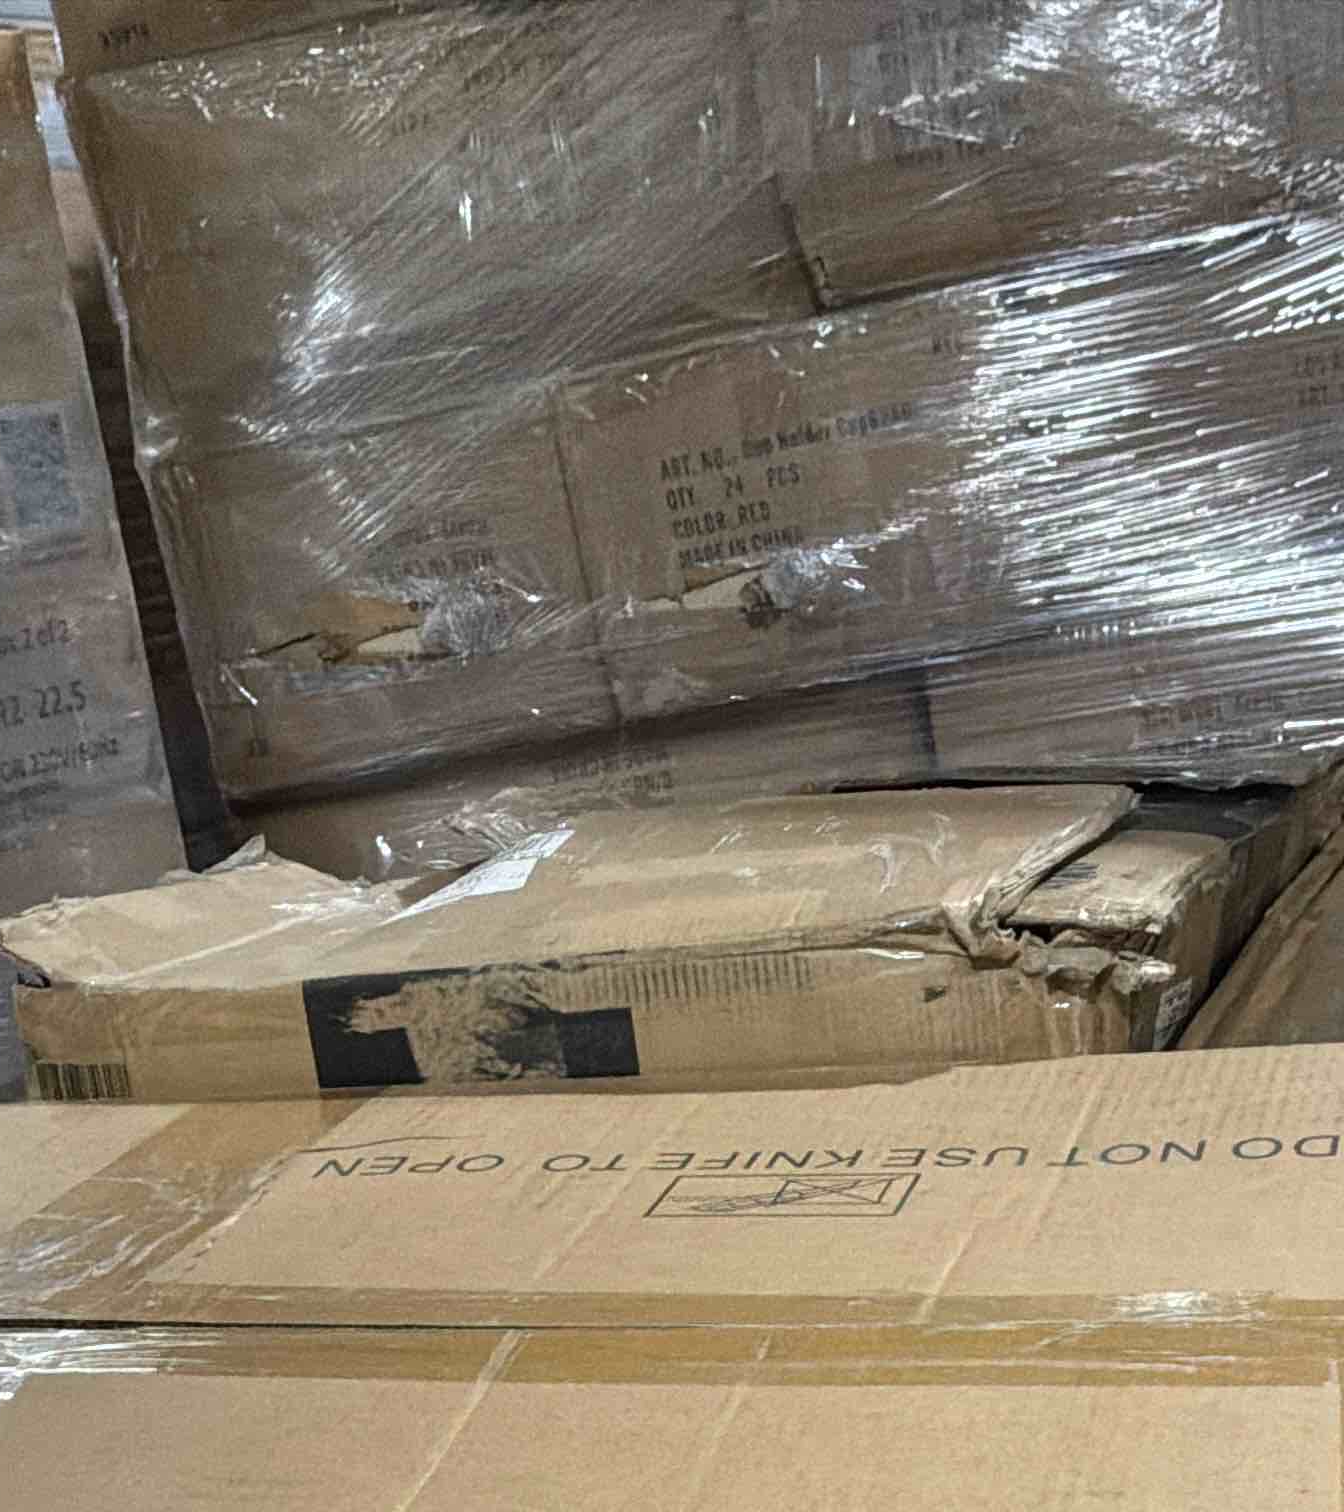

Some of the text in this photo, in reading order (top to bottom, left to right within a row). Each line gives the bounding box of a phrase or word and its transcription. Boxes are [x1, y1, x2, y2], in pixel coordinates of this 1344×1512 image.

[313, 1134, 1342, 1178] DO NOT USE KNIFE TO OPEN
